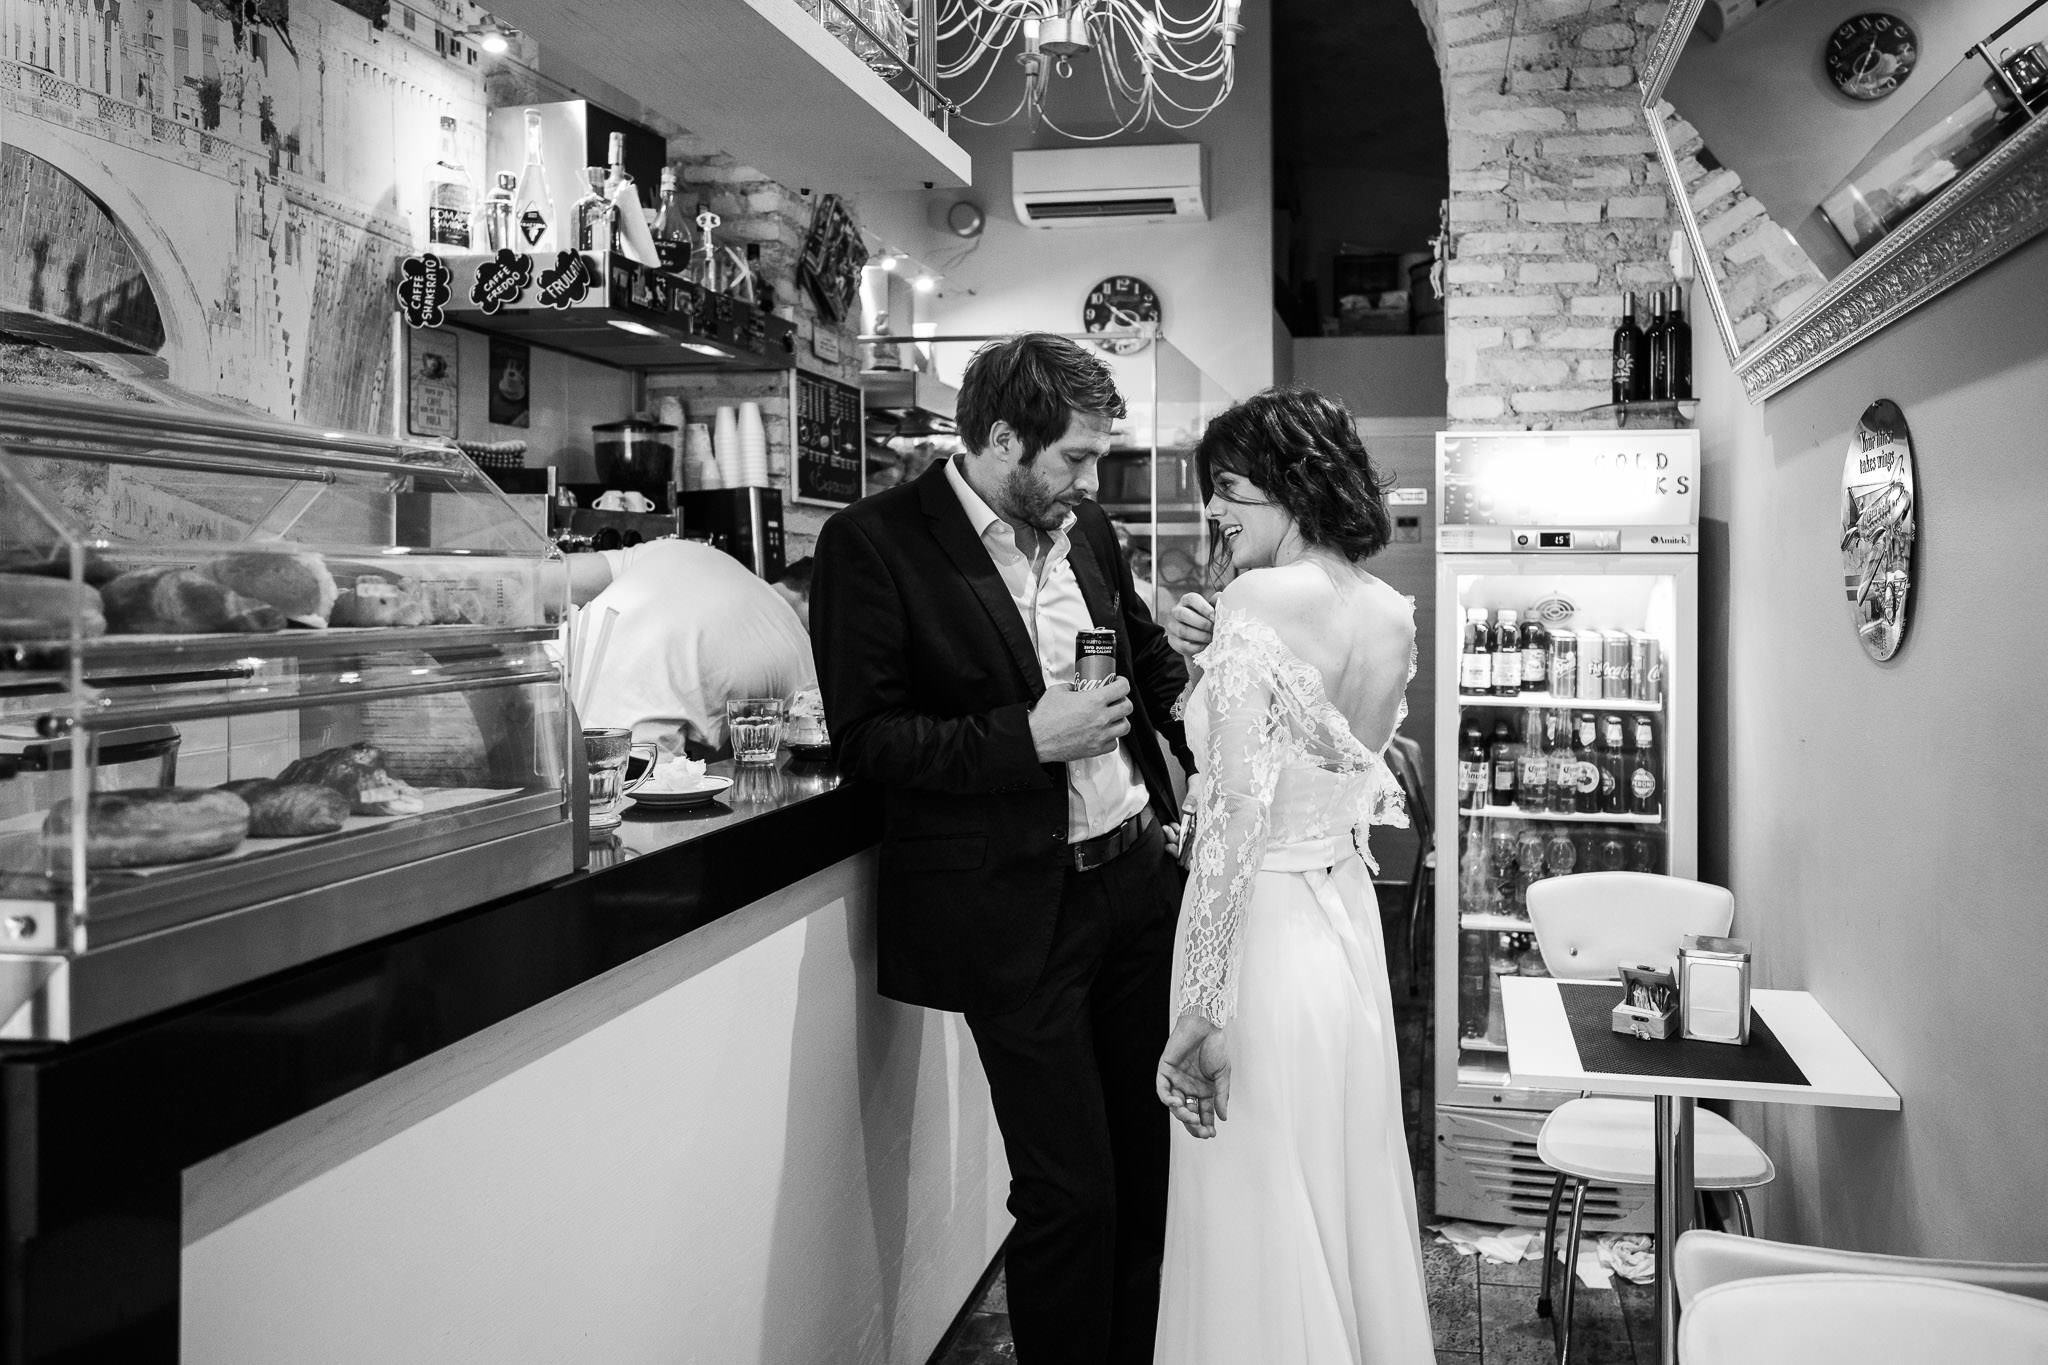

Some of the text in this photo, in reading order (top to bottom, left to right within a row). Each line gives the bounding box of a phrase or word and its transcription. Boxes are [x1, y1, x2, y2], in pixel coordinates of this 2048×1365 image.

[421, 260, 437, 319] SHAKERATO
[487, 271, 520, 302] FREDDO
[1091, 293, 1104, 305] 10
[1086, 309, 1096, 320] 9
[1860, 431, 1876, 453] Your
[1860, 450, 1895, 474] takes wings
[1660, 536, 1687, 545] Amitek
